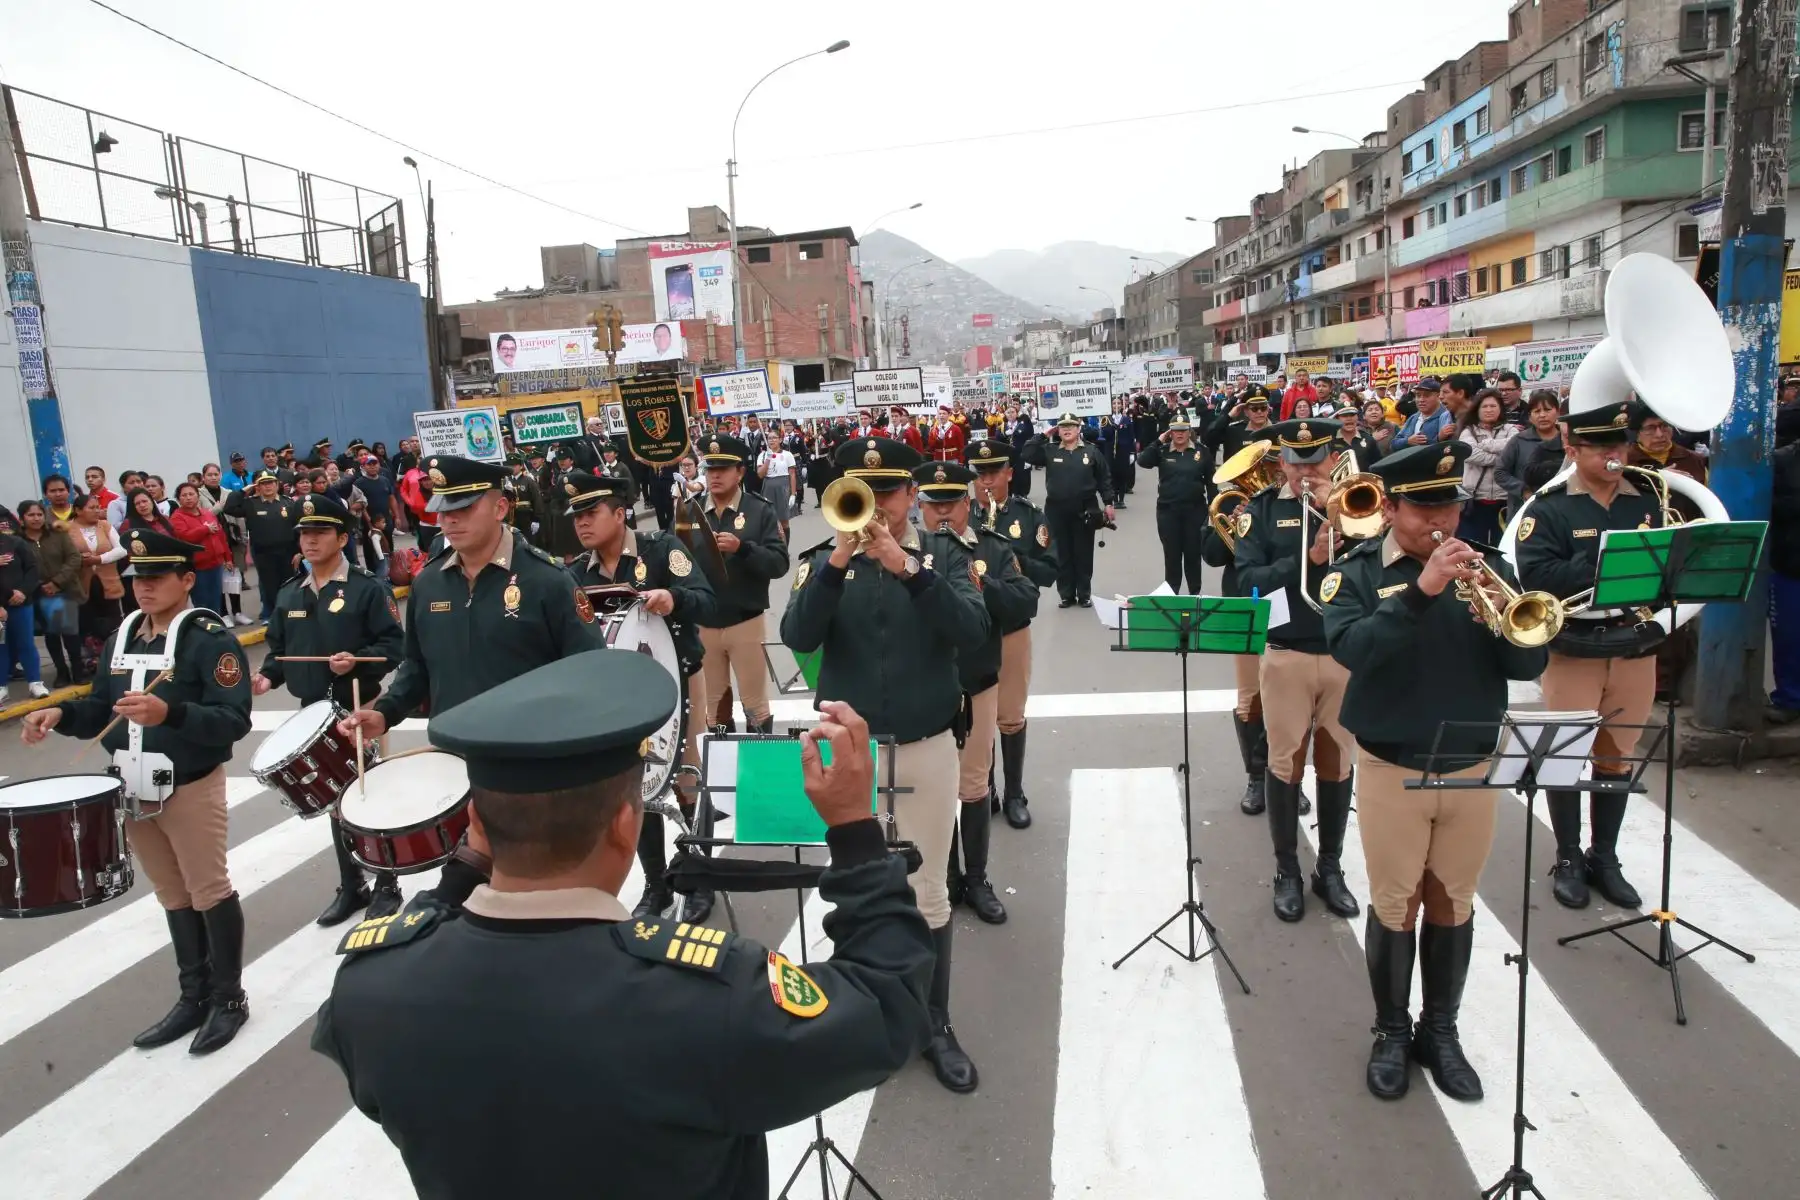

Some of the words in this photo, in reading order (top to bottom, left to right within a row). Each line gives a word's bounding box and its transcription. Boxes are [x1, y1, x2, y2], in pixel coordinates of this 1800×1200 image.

[520, 339, 556, 348] Enrique
[1420, 354, 1484, 368] MAGISTER
[1552, 352, 1588, 362] PERUAN
[1552, 362, 1581, 372] JAPON
[1150, 370, 1182, 378] COMISARIA
[1060, 388, 1085, 398] GABRIELA
[1086, 386, 1107, 396] MISTRAL
[644, 395, 676, 406] ROBLES
[878, 394, 890, 402] UGEL
[432, 418, 447, 427] NACIONAL
[526, 412, 566, 426] COMISARIA
[612, 420, 624, 428] VIL
[519, 428, 538, 440] SAN
[541, 424, 578, 438] ANDRES
[642, 772, 661, 794] TADA
